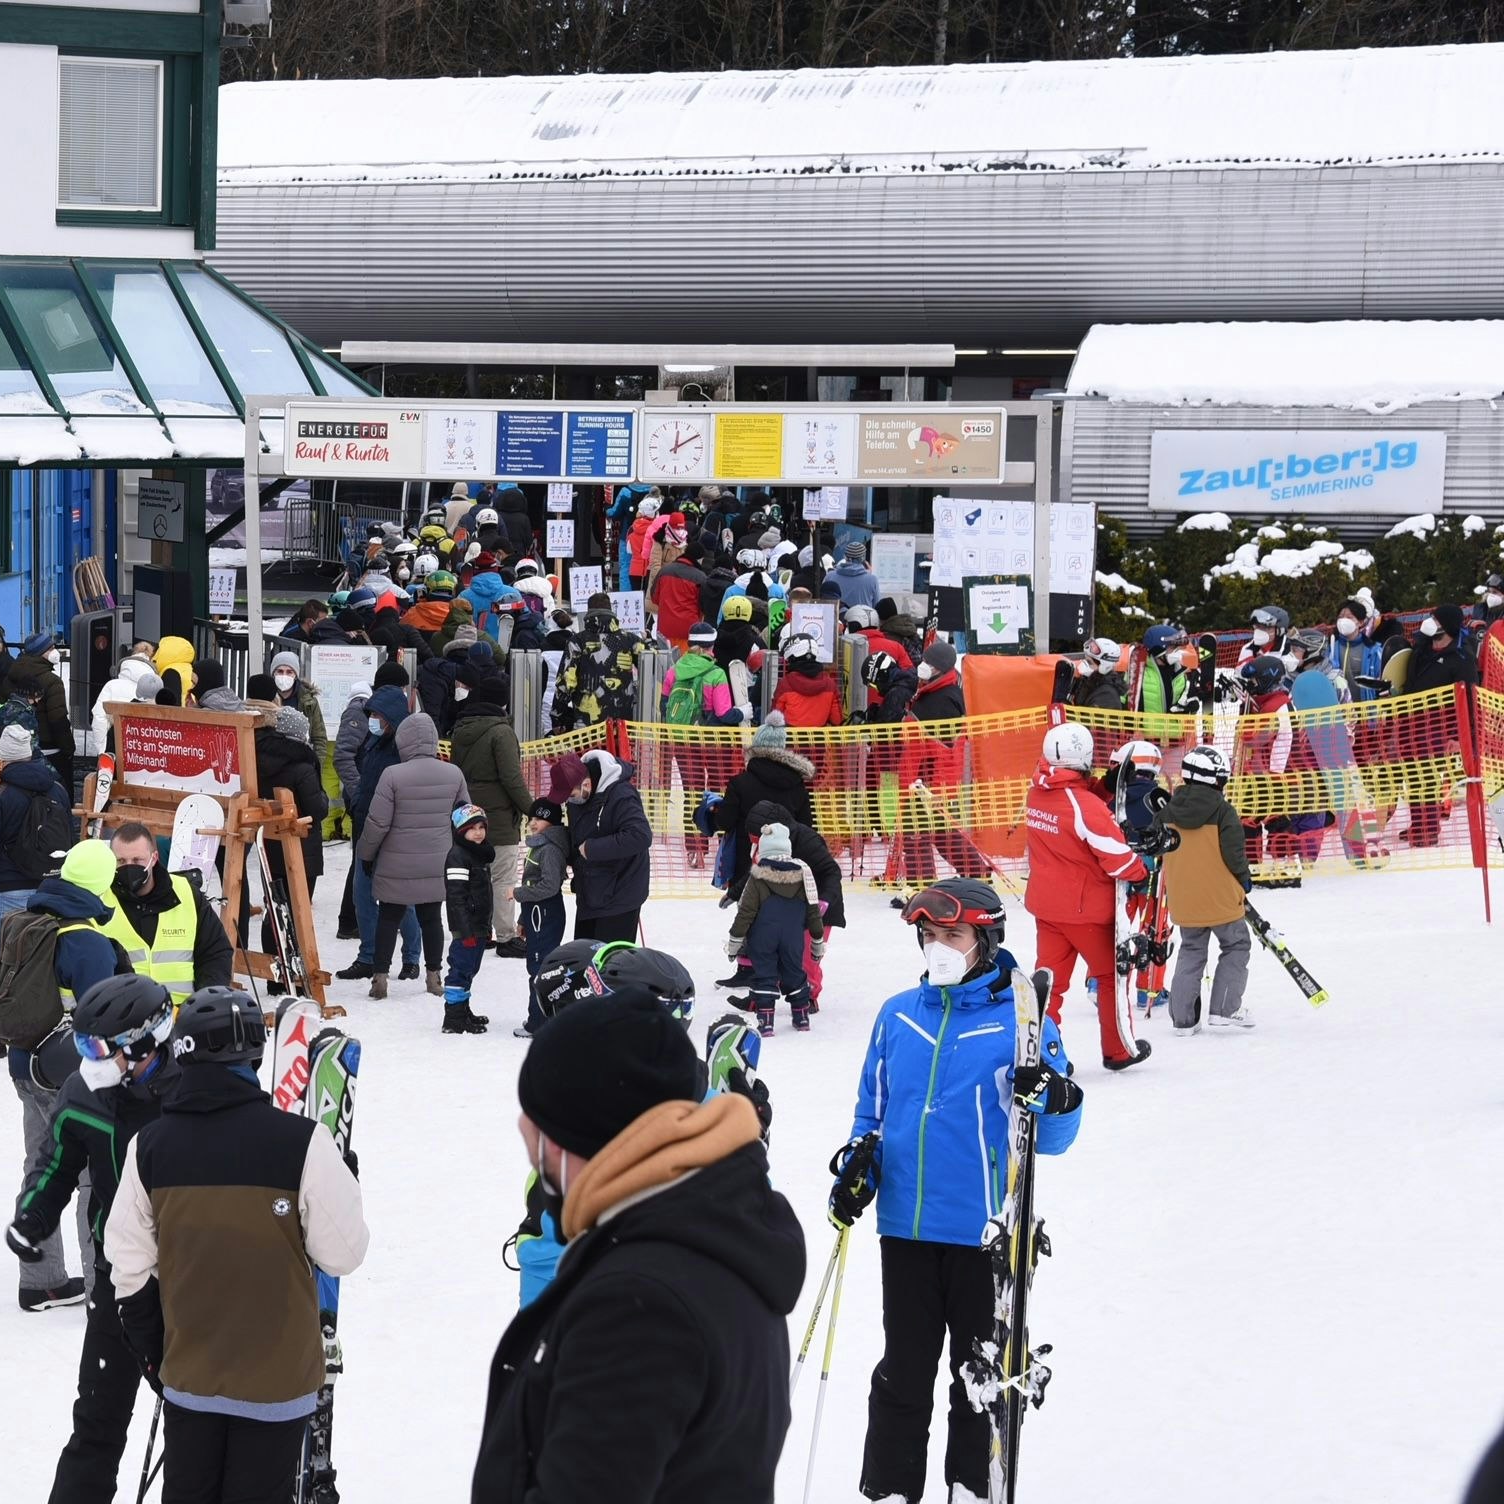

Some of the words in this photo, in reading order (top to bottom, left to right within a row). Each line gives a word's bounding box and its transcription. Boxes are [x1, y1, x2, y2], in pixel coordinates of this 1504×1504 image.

[400, 413, 420, 421] EVN
[865, 420, 880, 430] Die
[882, 420, 916, 430] schnelle
[972, 425, 992, 434] 1450
[865, 430, 883, 440] Hilfe
[885, 432, 900, 440] am
[865, 440, 897, 449] Telefon.
[296, 441, 330, 462] Rauf
[331, 443, 342, 461] &
[346, 442, 389, 462] Runter
[1271, 473, 1374, 501] SEMMERING
[125, 724, 139, 735] Am
[140, 725, 182, 741] schönsten
[143, 742, 156, 752] am
[158, 742, 206, 760] Semmering:
[126, 752, 168, 768] Miteinand!
